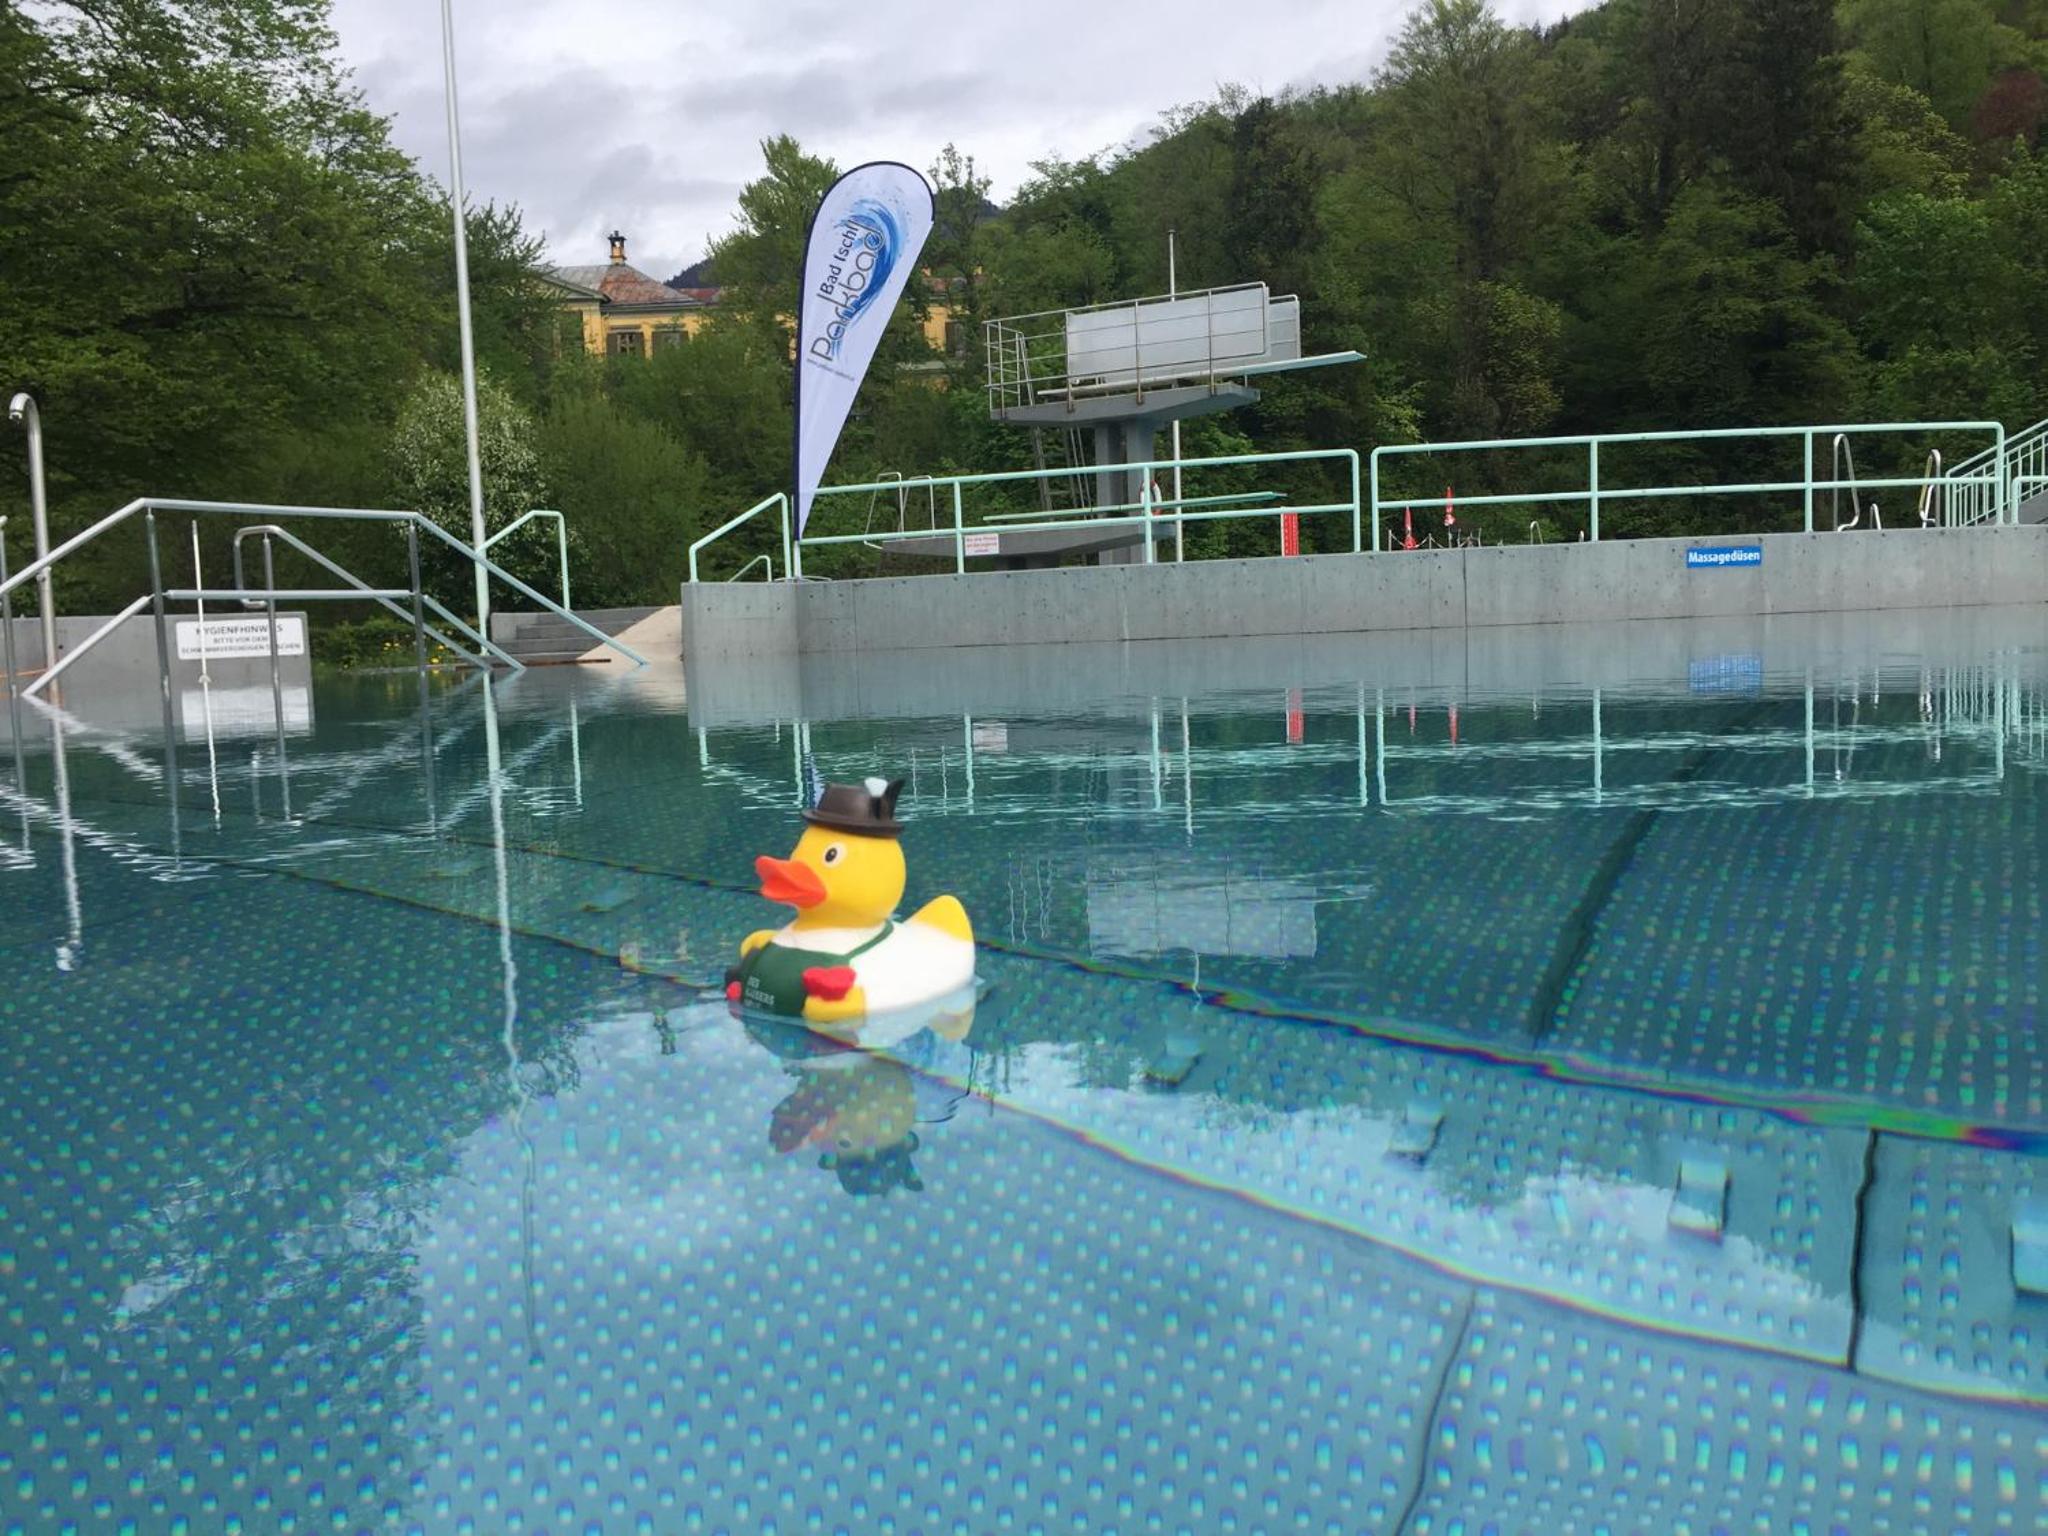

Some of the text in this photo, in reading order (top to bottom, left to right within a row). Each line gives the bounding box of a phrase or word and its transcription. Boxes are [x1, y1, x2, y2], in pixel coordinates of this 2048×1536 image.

[820, 226, 860, 296] Bad Ischl
[810, 219, 884, 362] Parkbad
[1688, 550, 1760, 564] Massagedüsen
[196, 624, 283, 635] YGIENEHINWS
